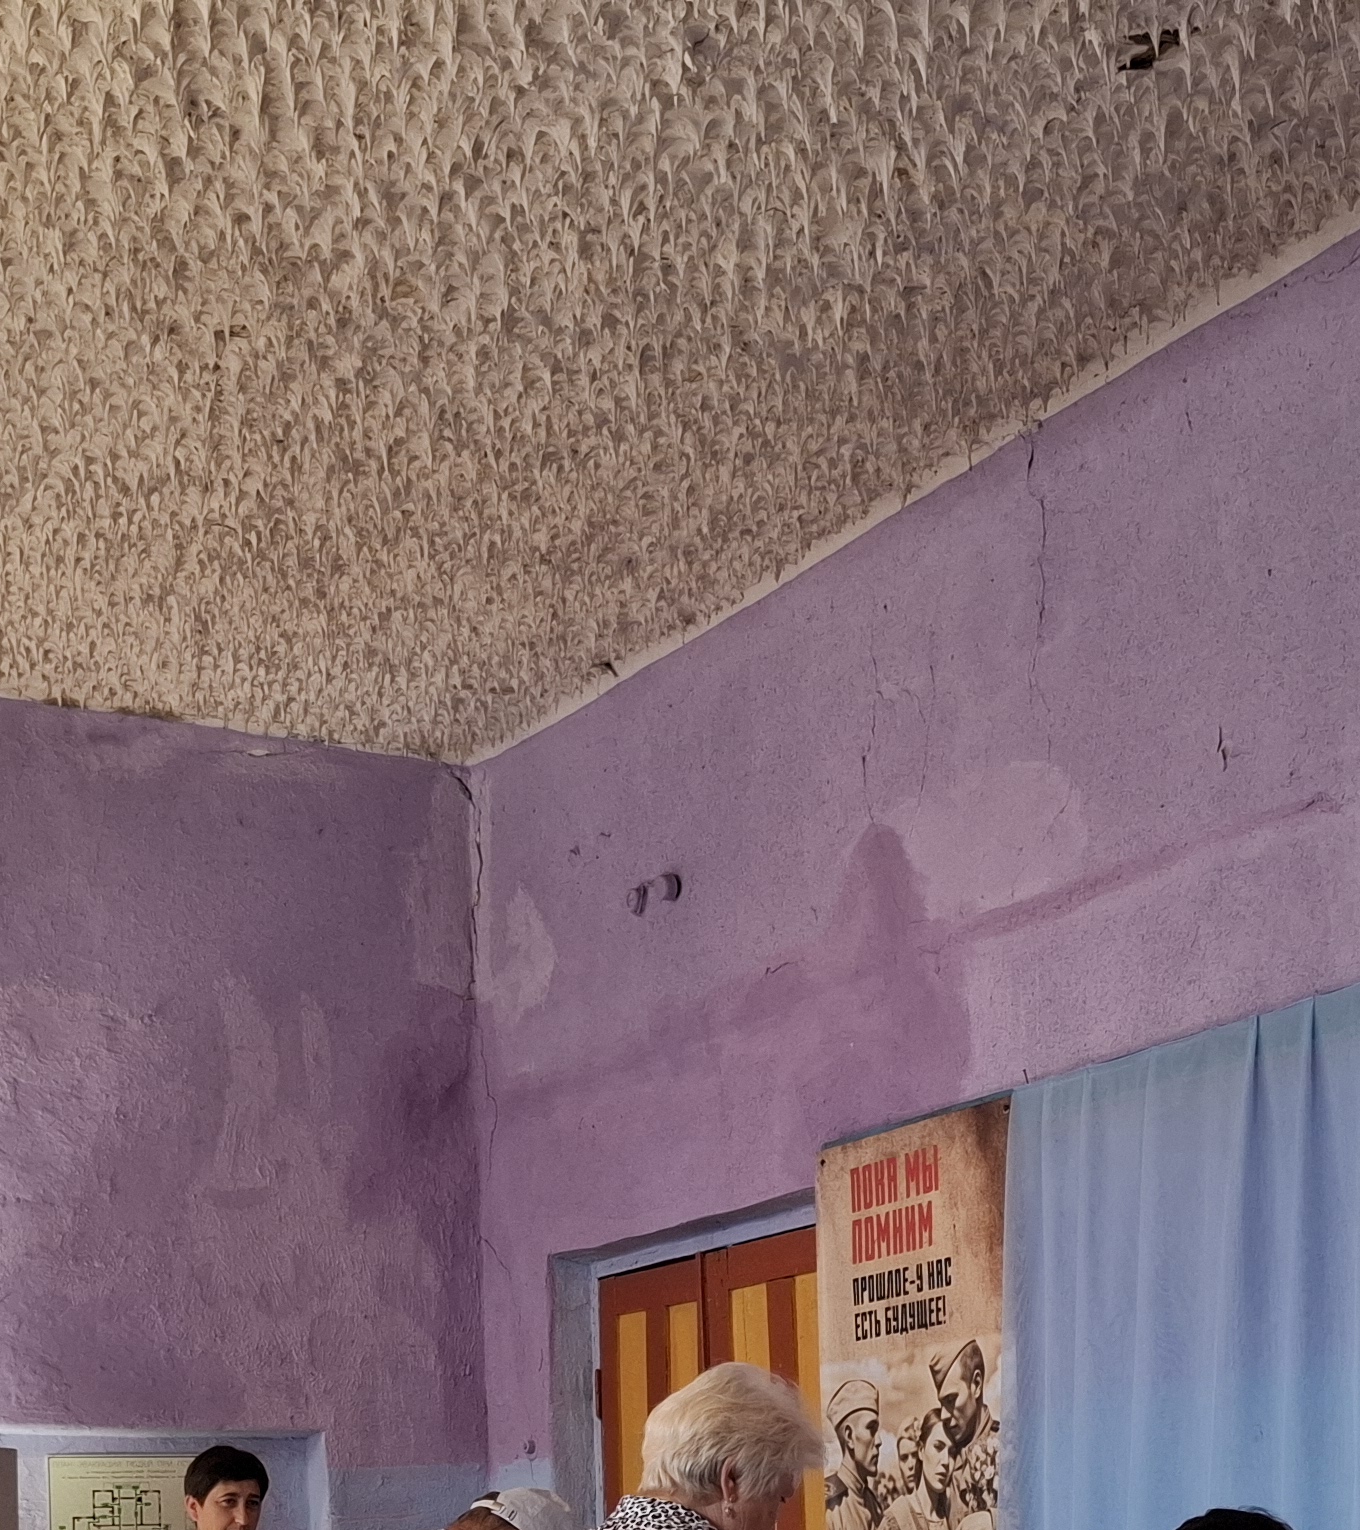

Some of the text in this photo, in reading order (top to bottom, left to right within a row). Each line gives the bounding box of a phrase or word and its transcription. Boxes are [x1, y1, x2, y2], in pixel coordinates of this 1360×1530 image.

[850, 1145, 939, 1213] ПОКА МЫ
[852, 1200, 933, 1265] ПОМНИМ
[927, 1256, 952, 1291] НАС
[854, 1295, 947, 1342] ЕСТЬ БУДУЩЕЕ!
